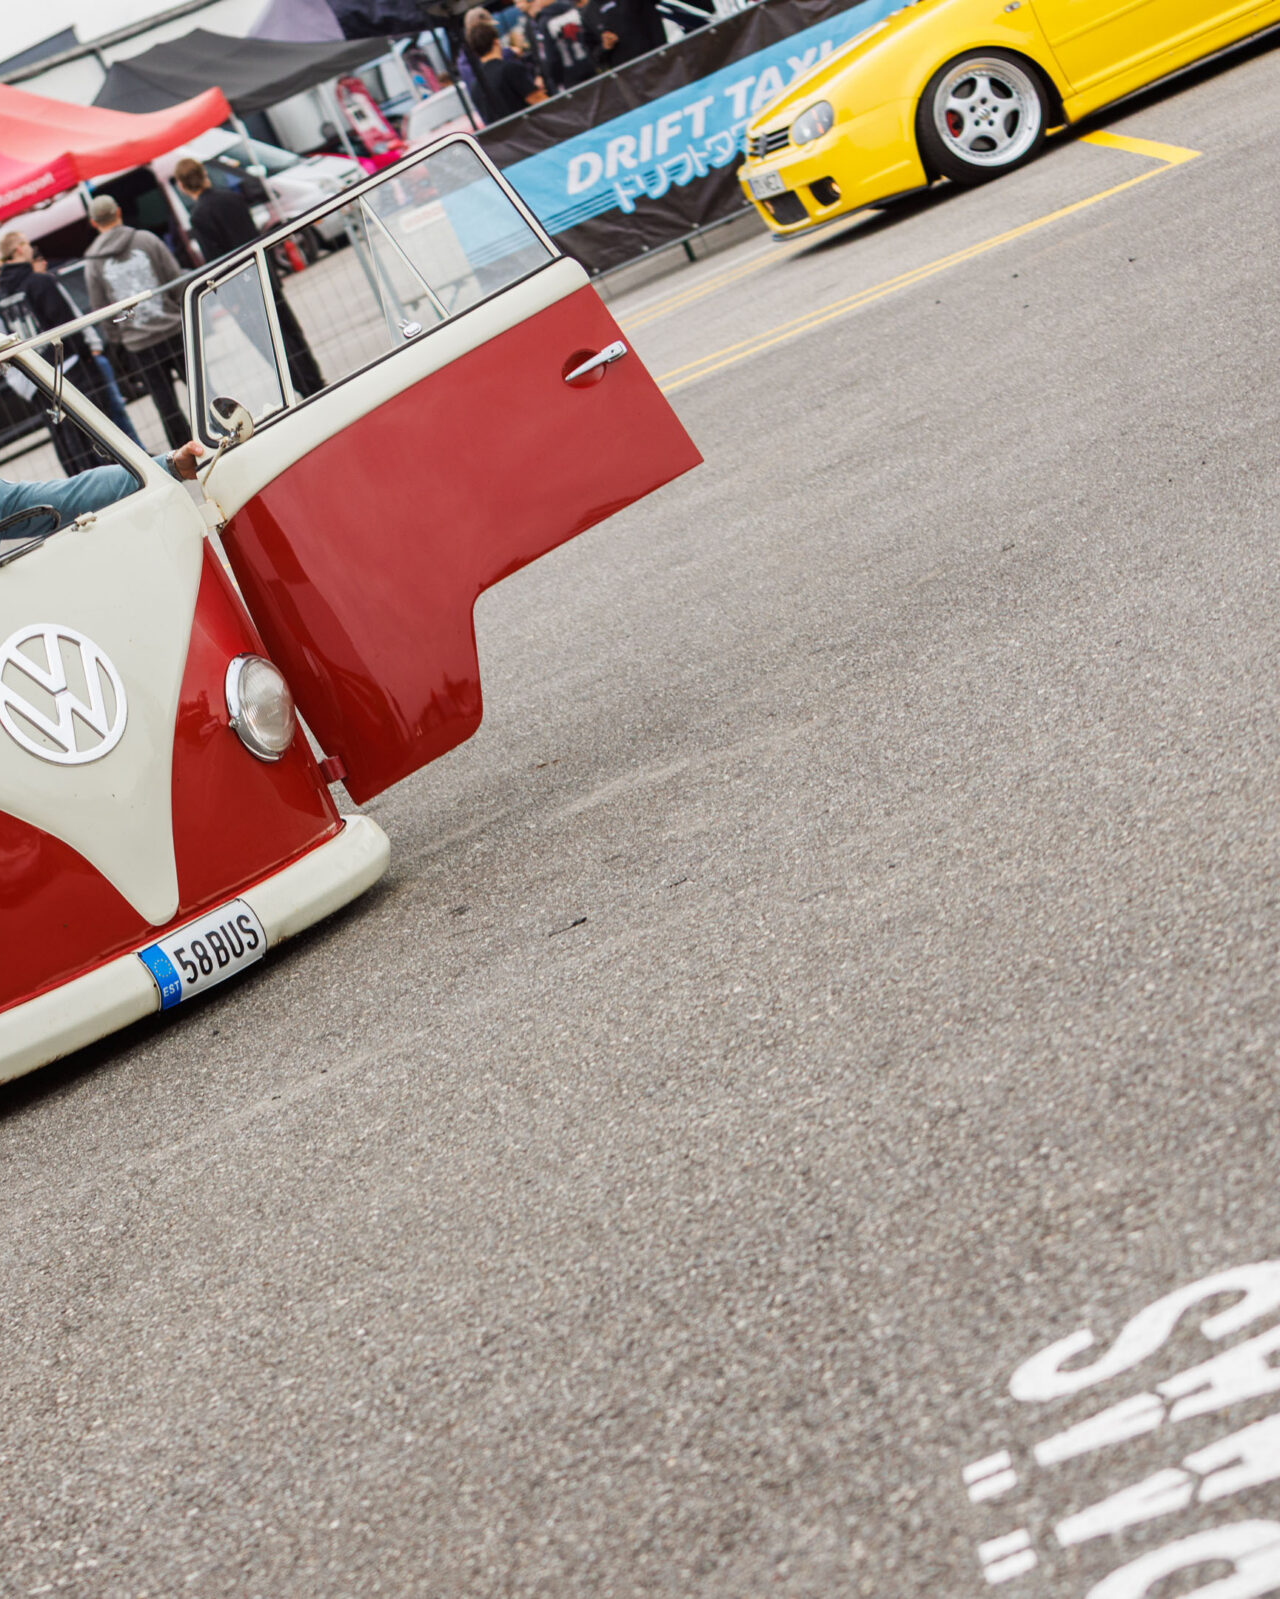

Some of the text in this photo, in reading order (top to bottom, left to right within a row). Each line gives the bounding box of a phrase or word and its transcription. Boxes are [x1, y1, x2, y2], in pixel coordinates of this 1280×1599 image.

[567, 95, 714, 195] DRIFT
[173, 914, 260, 985] 58BUS
[162, 980, 180, 998] EST
